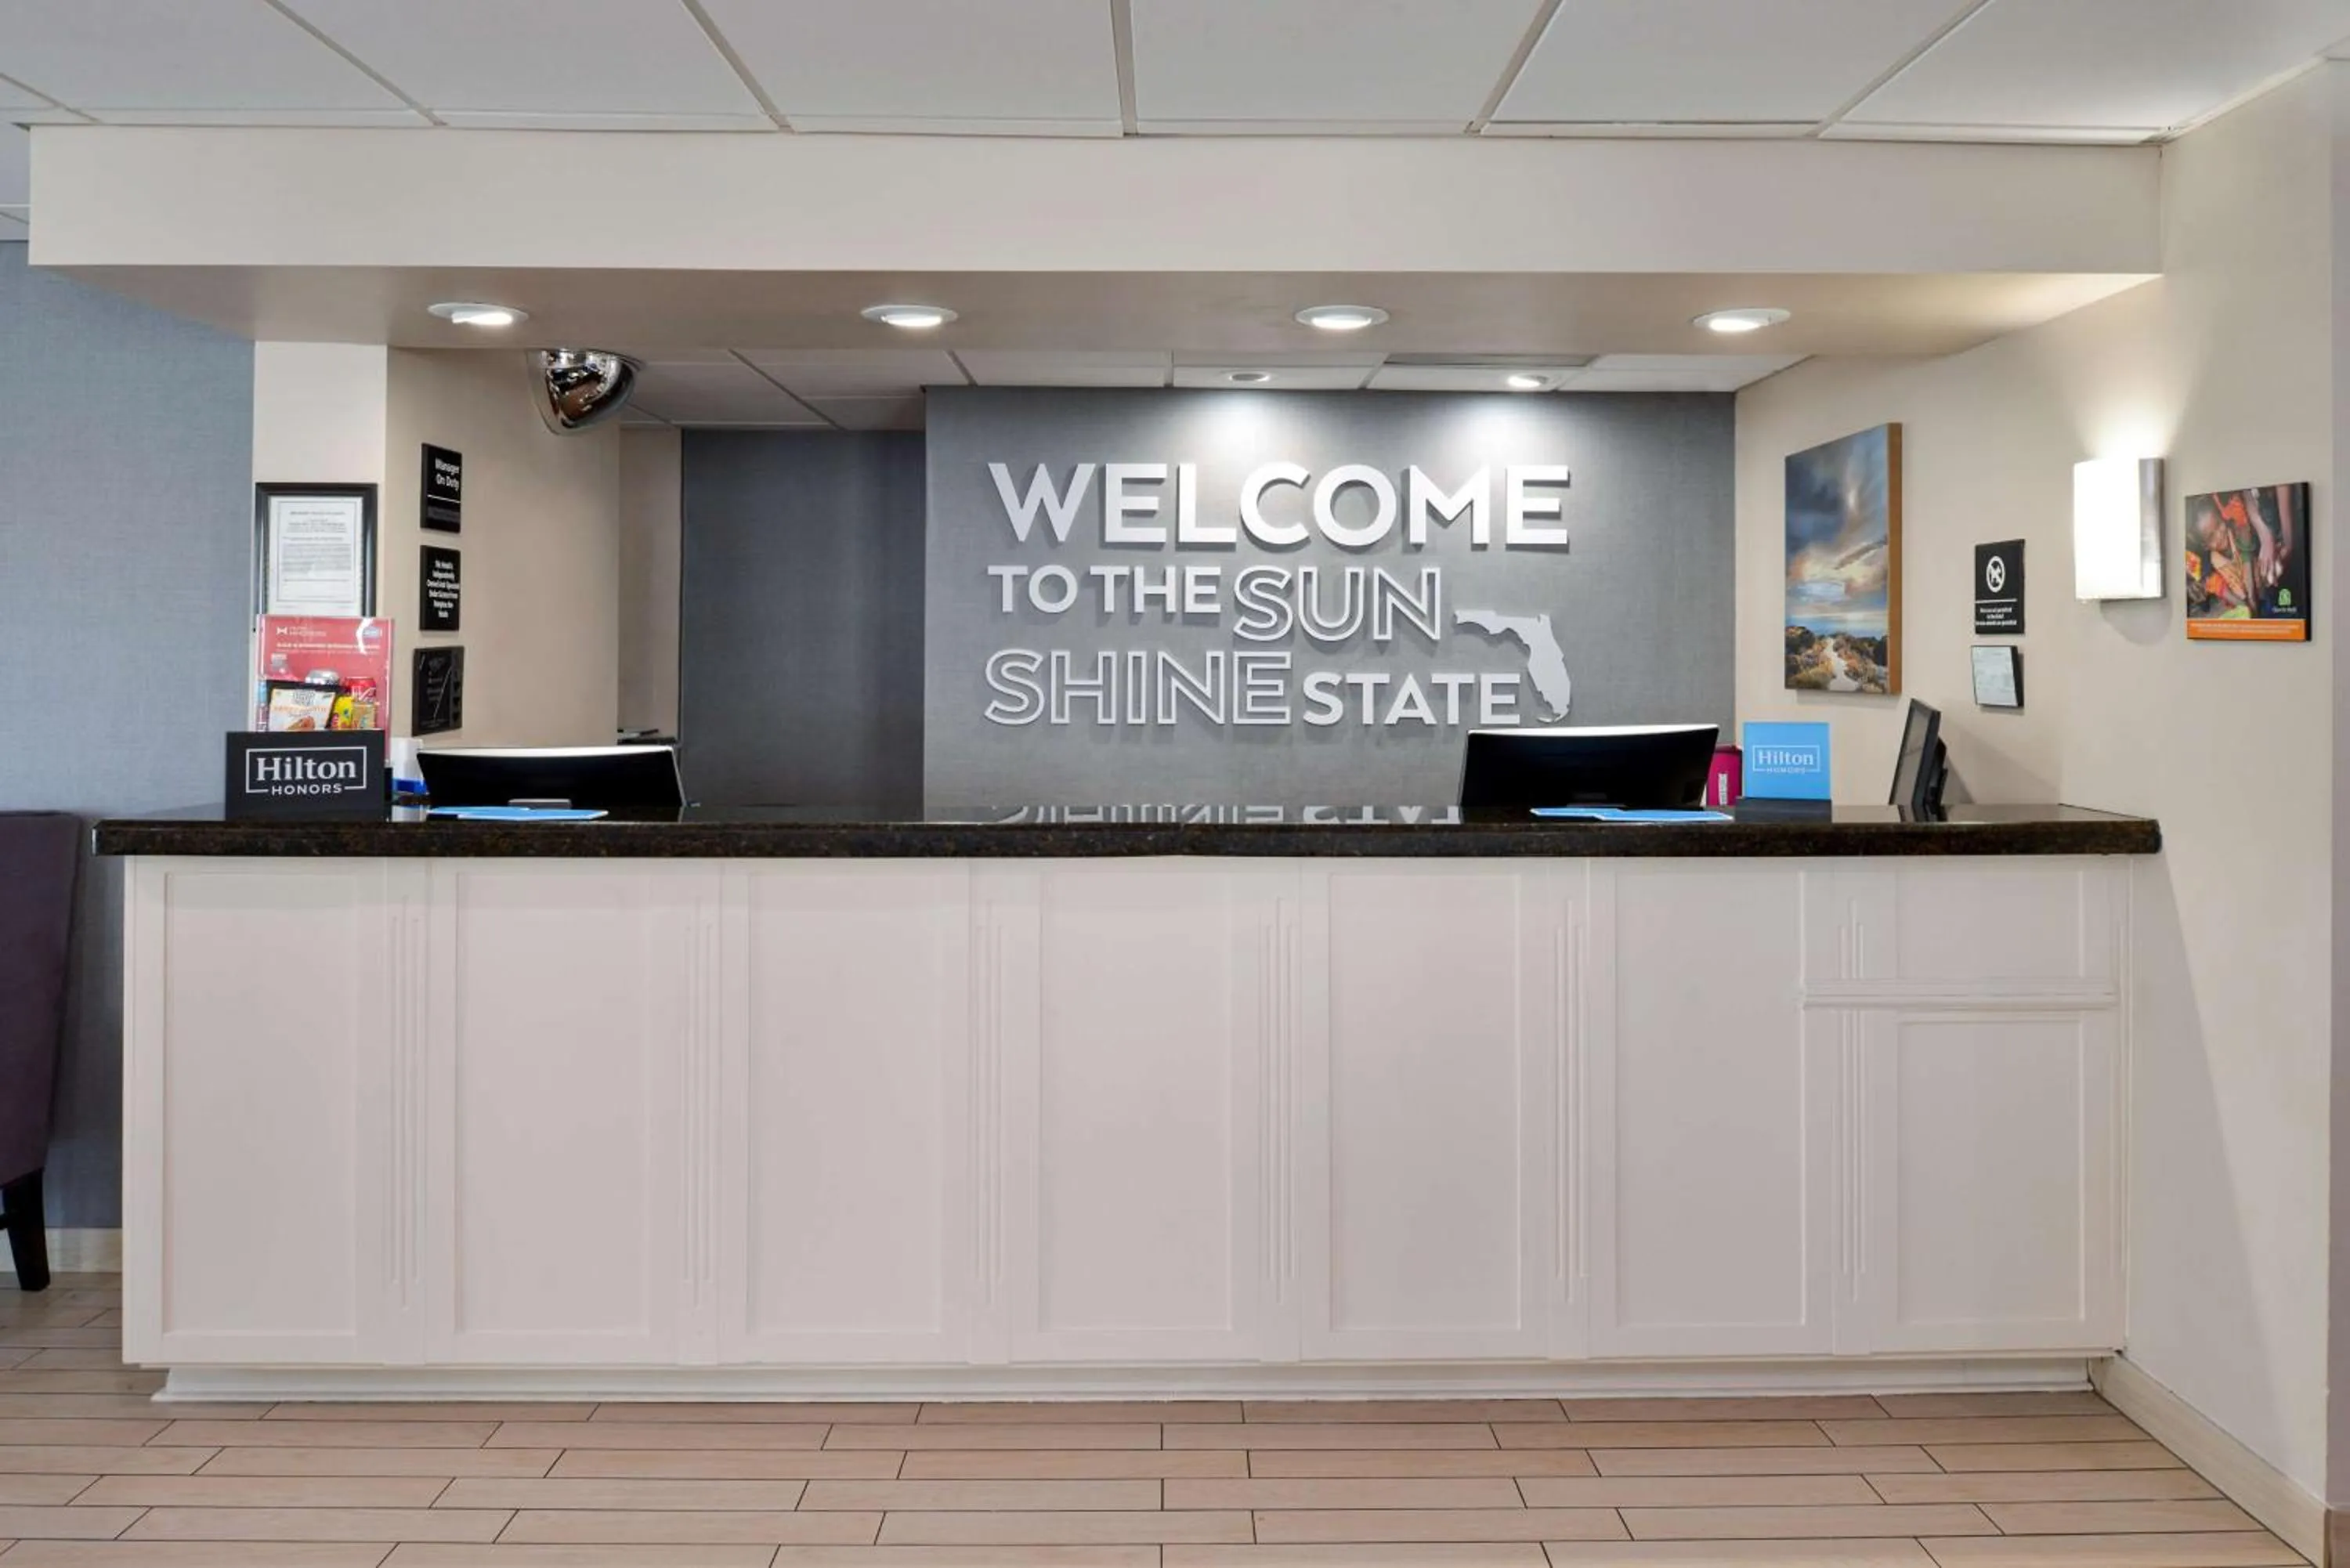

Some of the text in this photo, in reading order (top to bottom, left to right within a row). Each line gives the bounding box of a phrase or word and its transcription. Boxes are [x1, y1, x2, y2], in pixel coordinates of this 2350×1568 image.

[435, 457, 460, 475] Manager
[436, 473, 460, 492] On Duty
[987, 461, 1569, 547] WELCOME
[987, 564, 1441, 642] TO THE SUN
[983, 649, 1521, 726] SHINE STATE
[1757, 750, 1814, 766] Hilton
[256, 756, 356, 781] Hilton
[1766, 766, 1806, 775] HONORS
[271, 783, 342, 796] HONORS
